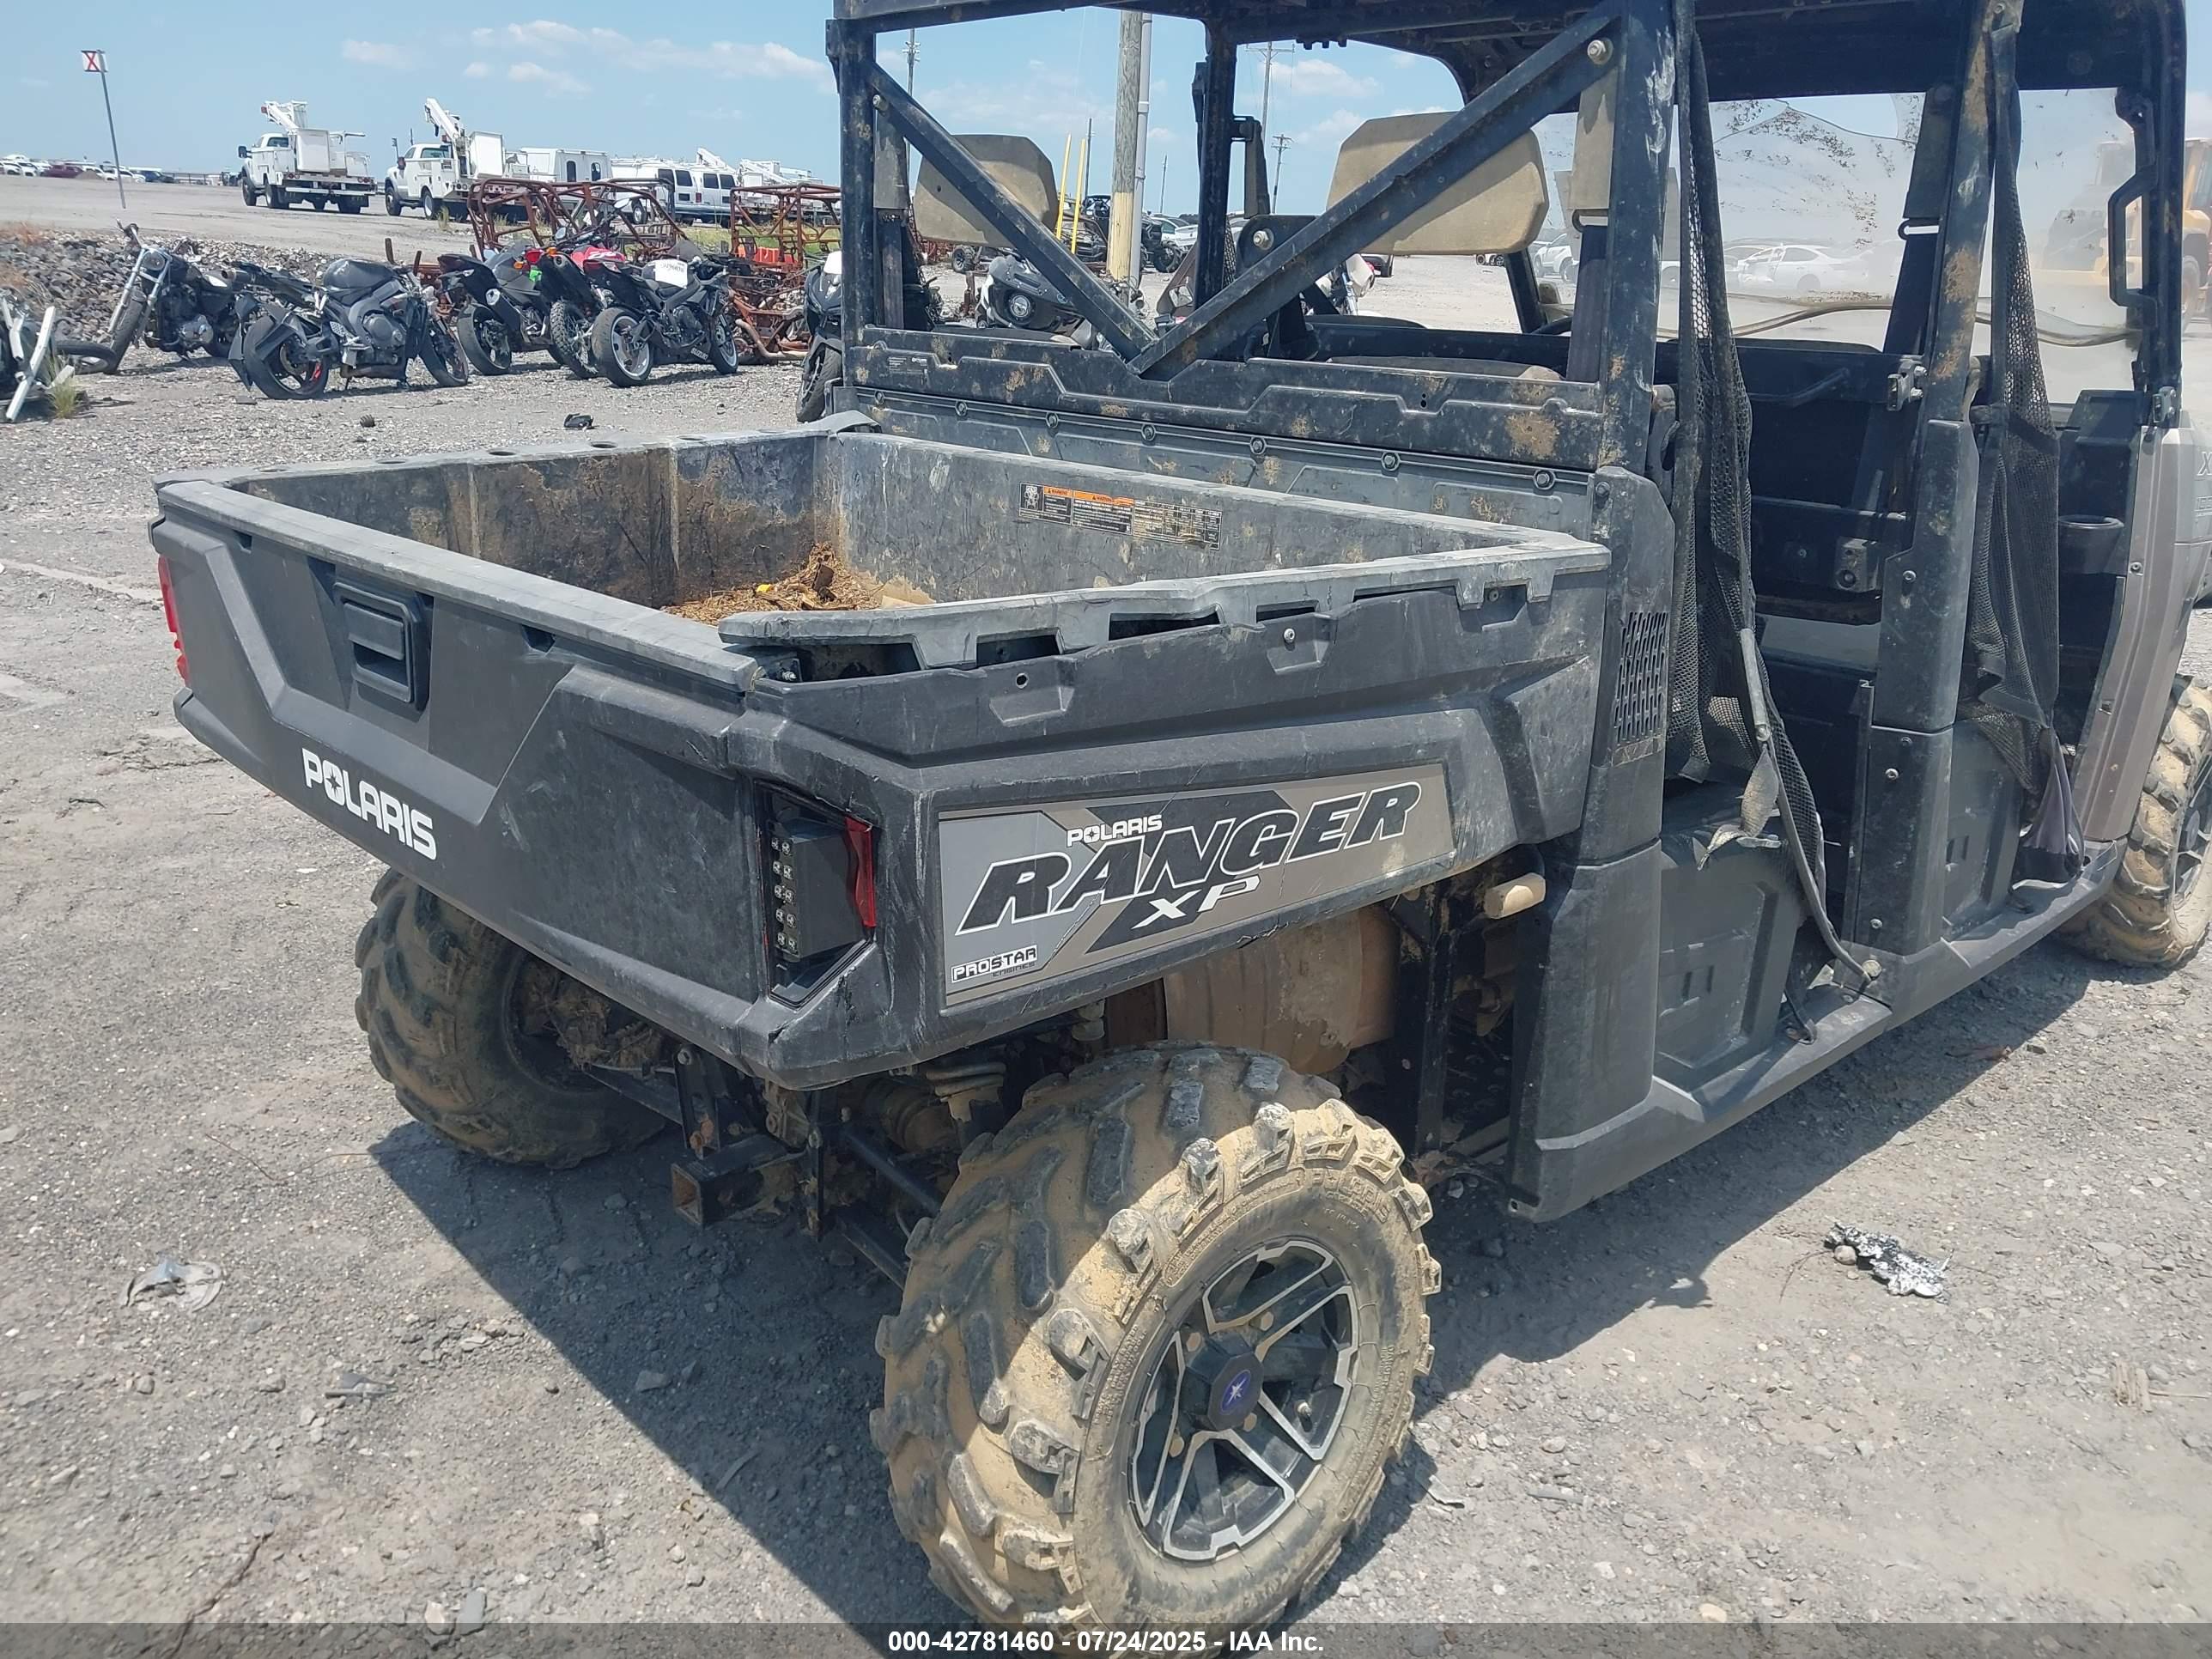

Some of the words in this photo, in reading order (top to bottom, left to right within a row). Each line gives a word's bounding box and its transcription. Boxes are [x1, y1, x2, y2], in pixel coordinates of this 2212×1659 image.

[302, 748, 437, 860] POLARIS
[1067, 815, 1163, 847] POLARIS
[955, 781, 1423, 936] RANGER
[1131, 875, 1261, 930] XP
[952, 947, 1036, 981] PROSTAR
[992, 963, 1036, 977] ENGINES
